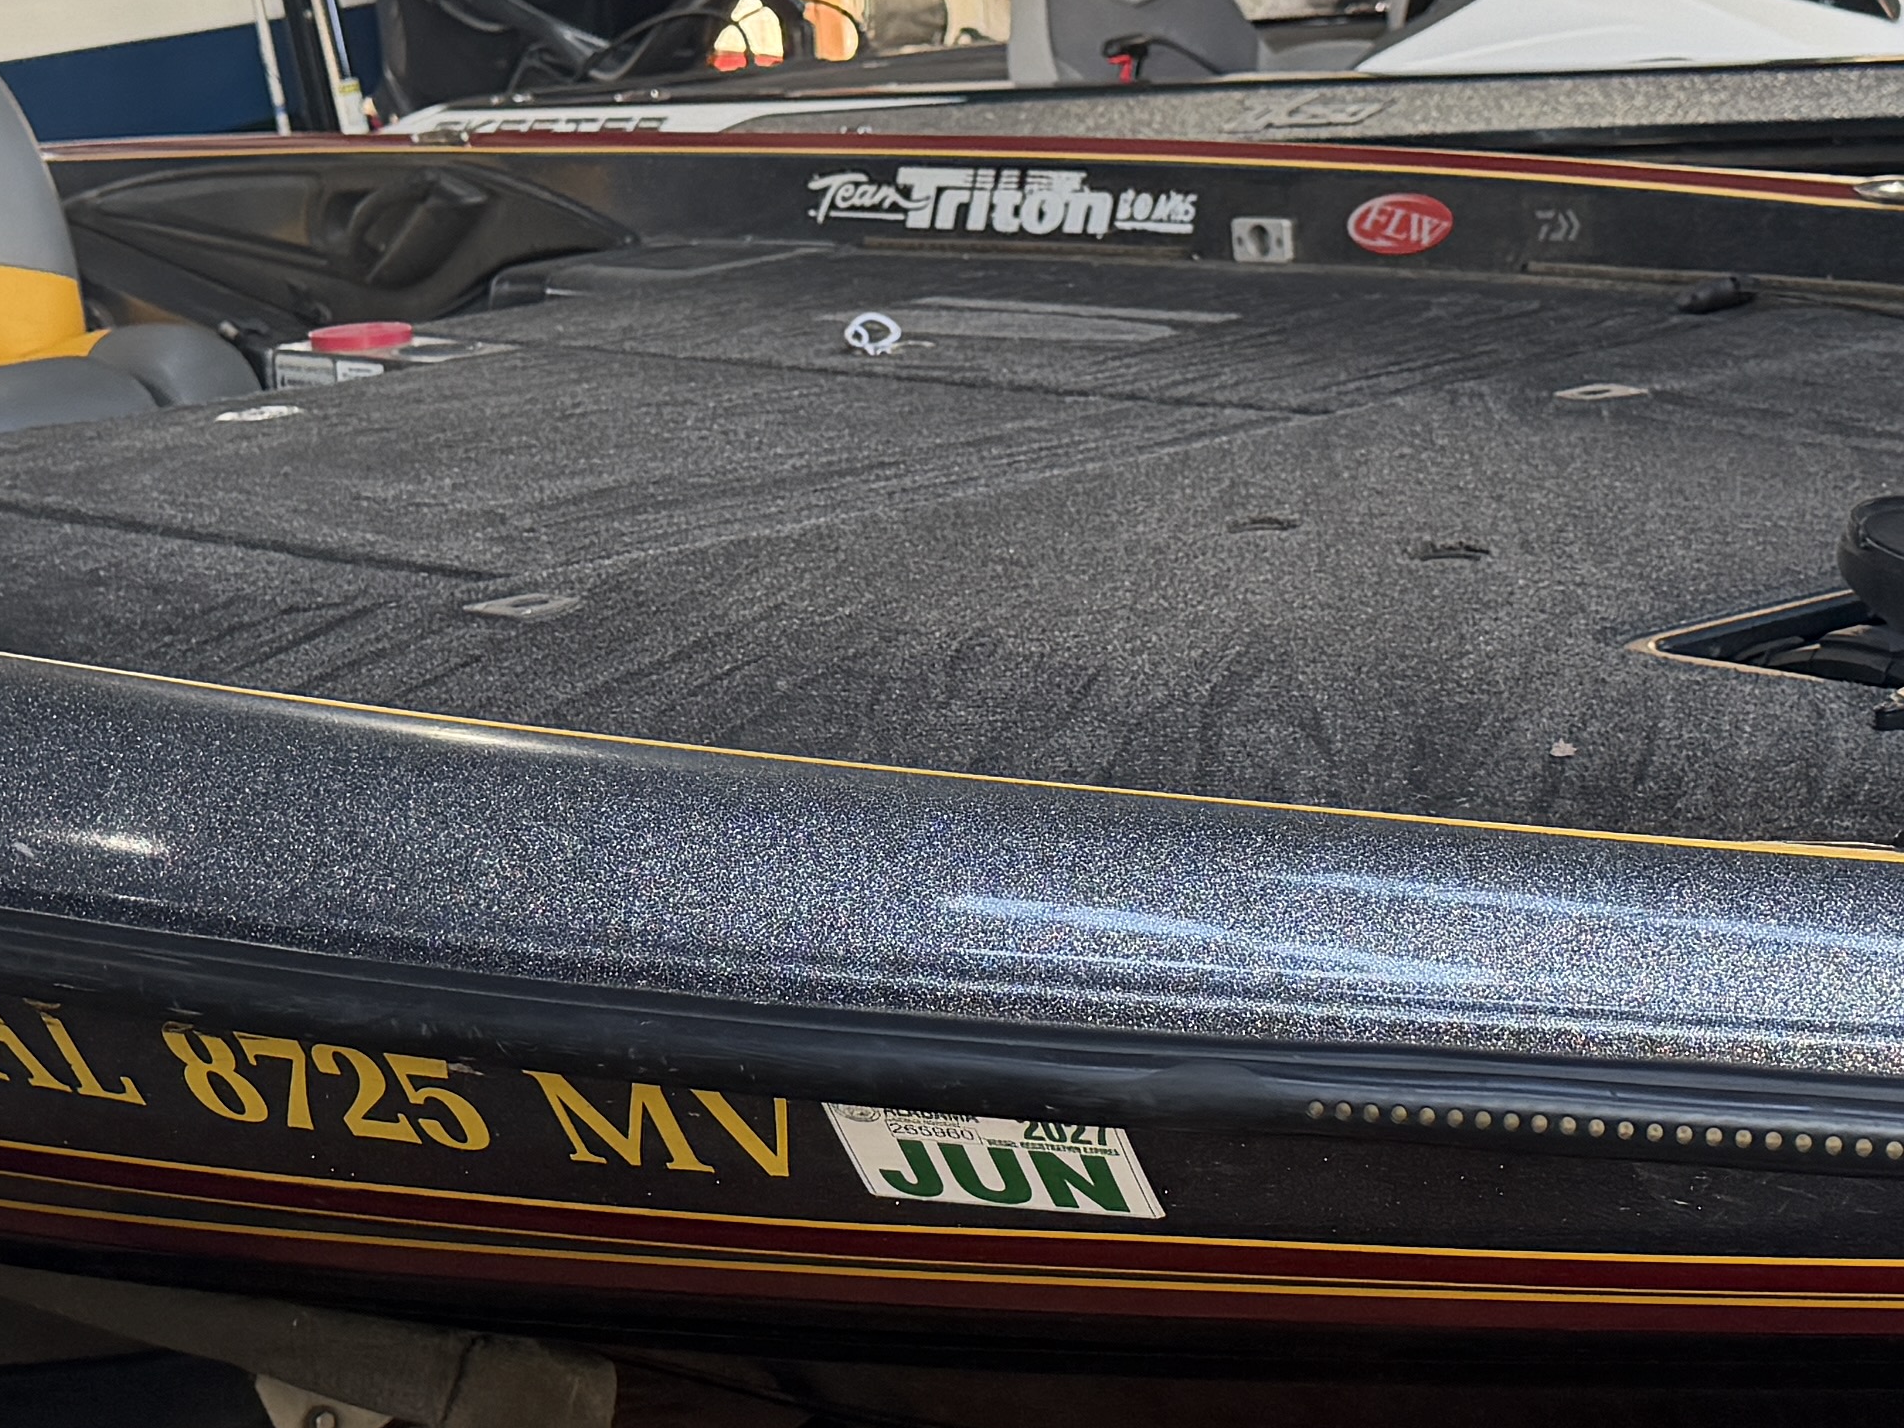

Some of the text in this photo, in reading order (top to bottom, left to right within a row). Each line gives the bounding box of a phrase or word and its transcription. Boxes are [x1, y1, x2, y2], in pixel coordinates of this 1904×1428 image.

[807, 171, 930, 224] Team
[897, 165, 1115, 236] Triton
[1361, 203, 1450, 247] FLW
[161, 1020, 491, 1151] 8725
[522, 1069, 790, 1177] MV
[879, 1138, 1131, 1213] JUN
